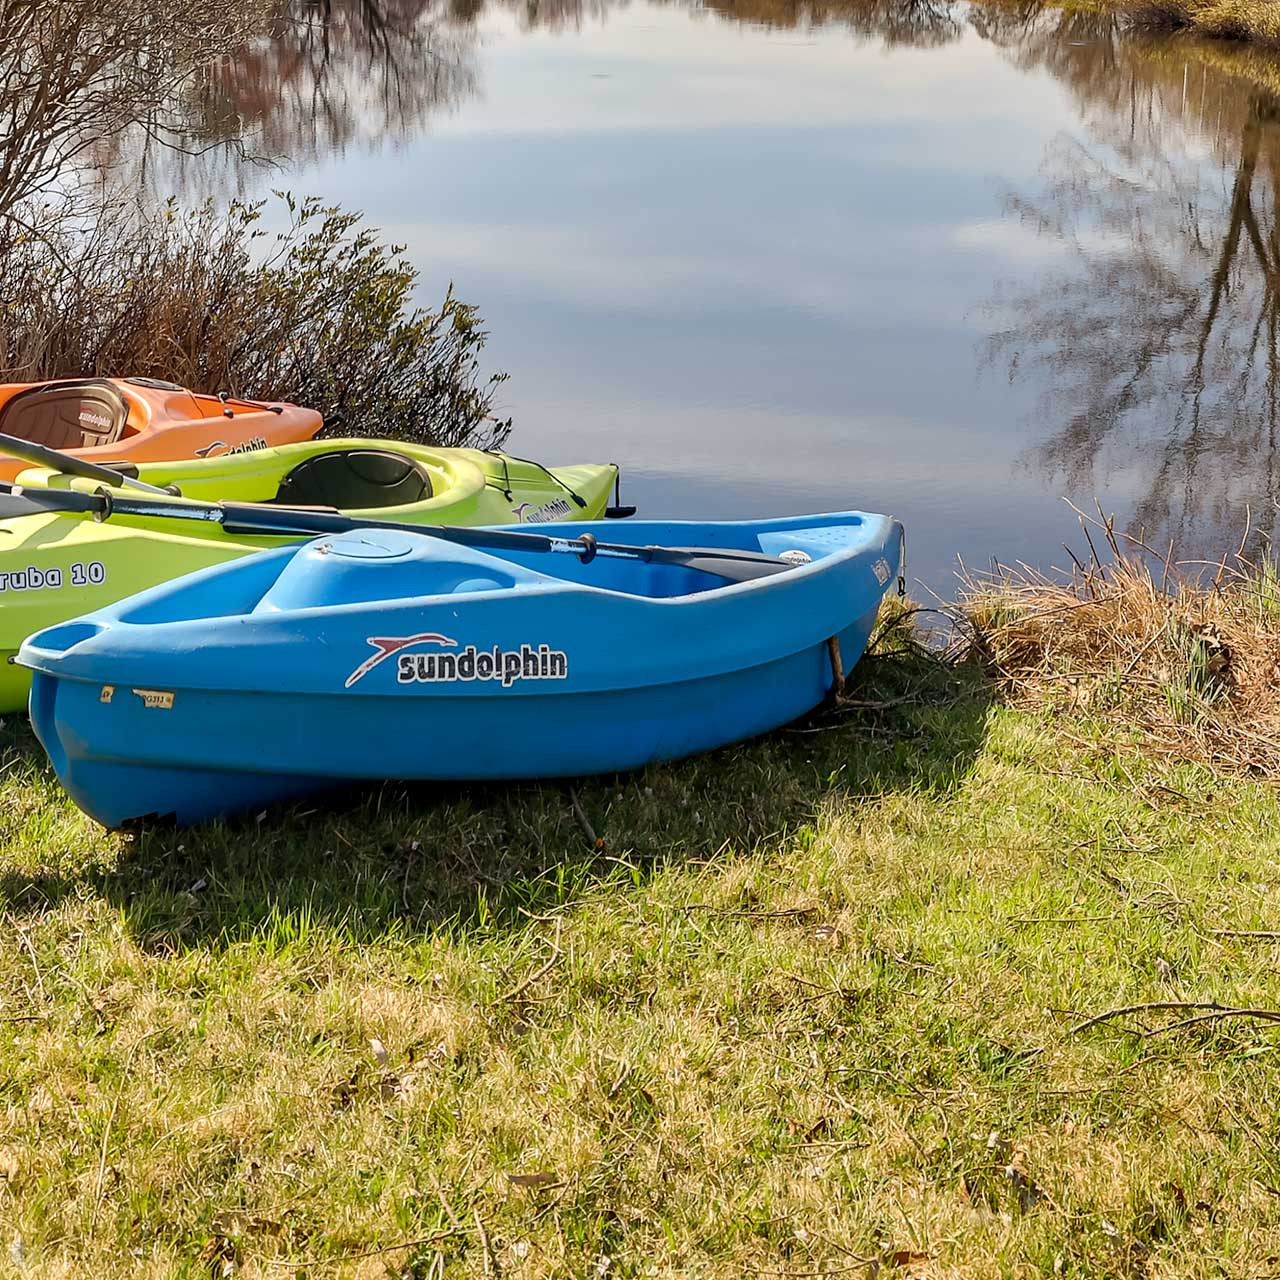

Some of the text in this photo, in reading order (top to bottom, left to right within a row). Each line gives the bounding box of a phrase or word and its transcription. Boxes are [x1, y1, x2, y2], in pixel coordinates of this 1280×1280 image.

[78, 412, 111, 427] sundolphin
[71, 561, 104, 585] 10
[397, 645, 568, 687] sundolphin
